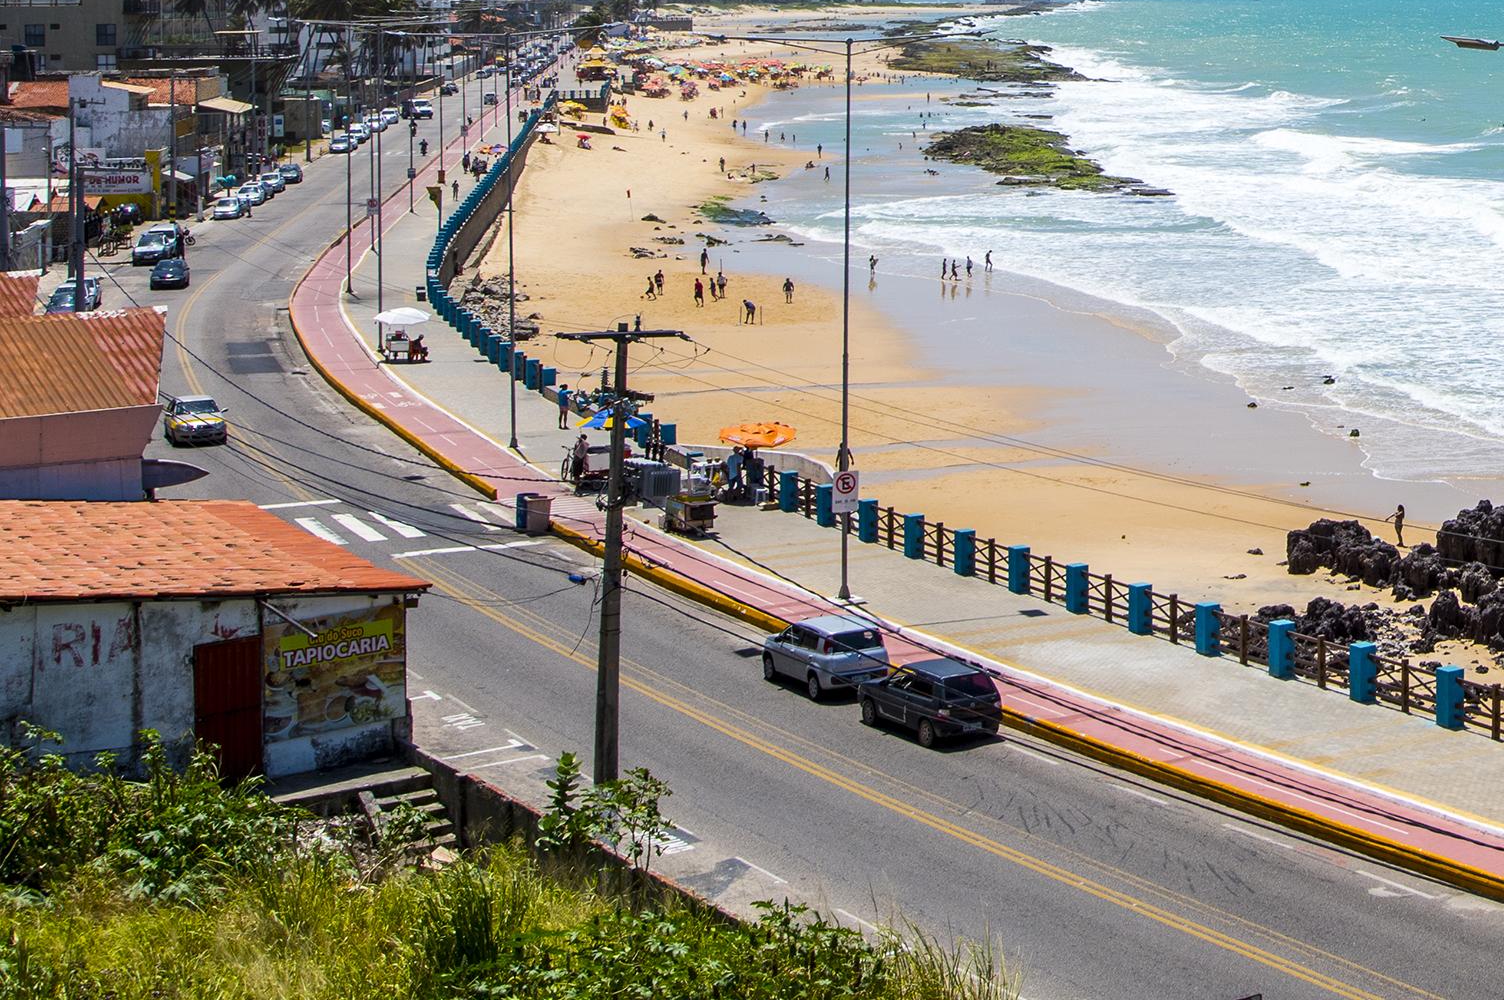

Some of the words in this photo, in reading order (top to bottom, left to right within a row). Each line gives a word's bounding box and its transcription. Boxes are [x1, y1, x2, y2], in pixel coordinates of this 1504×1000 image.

[105, 174, 139, 185] HUMOR
[326, 629, 339, 642] do
[340, 626, 364, 640] Suco
[283, 634, 390, 668] TAPIOCARIA
